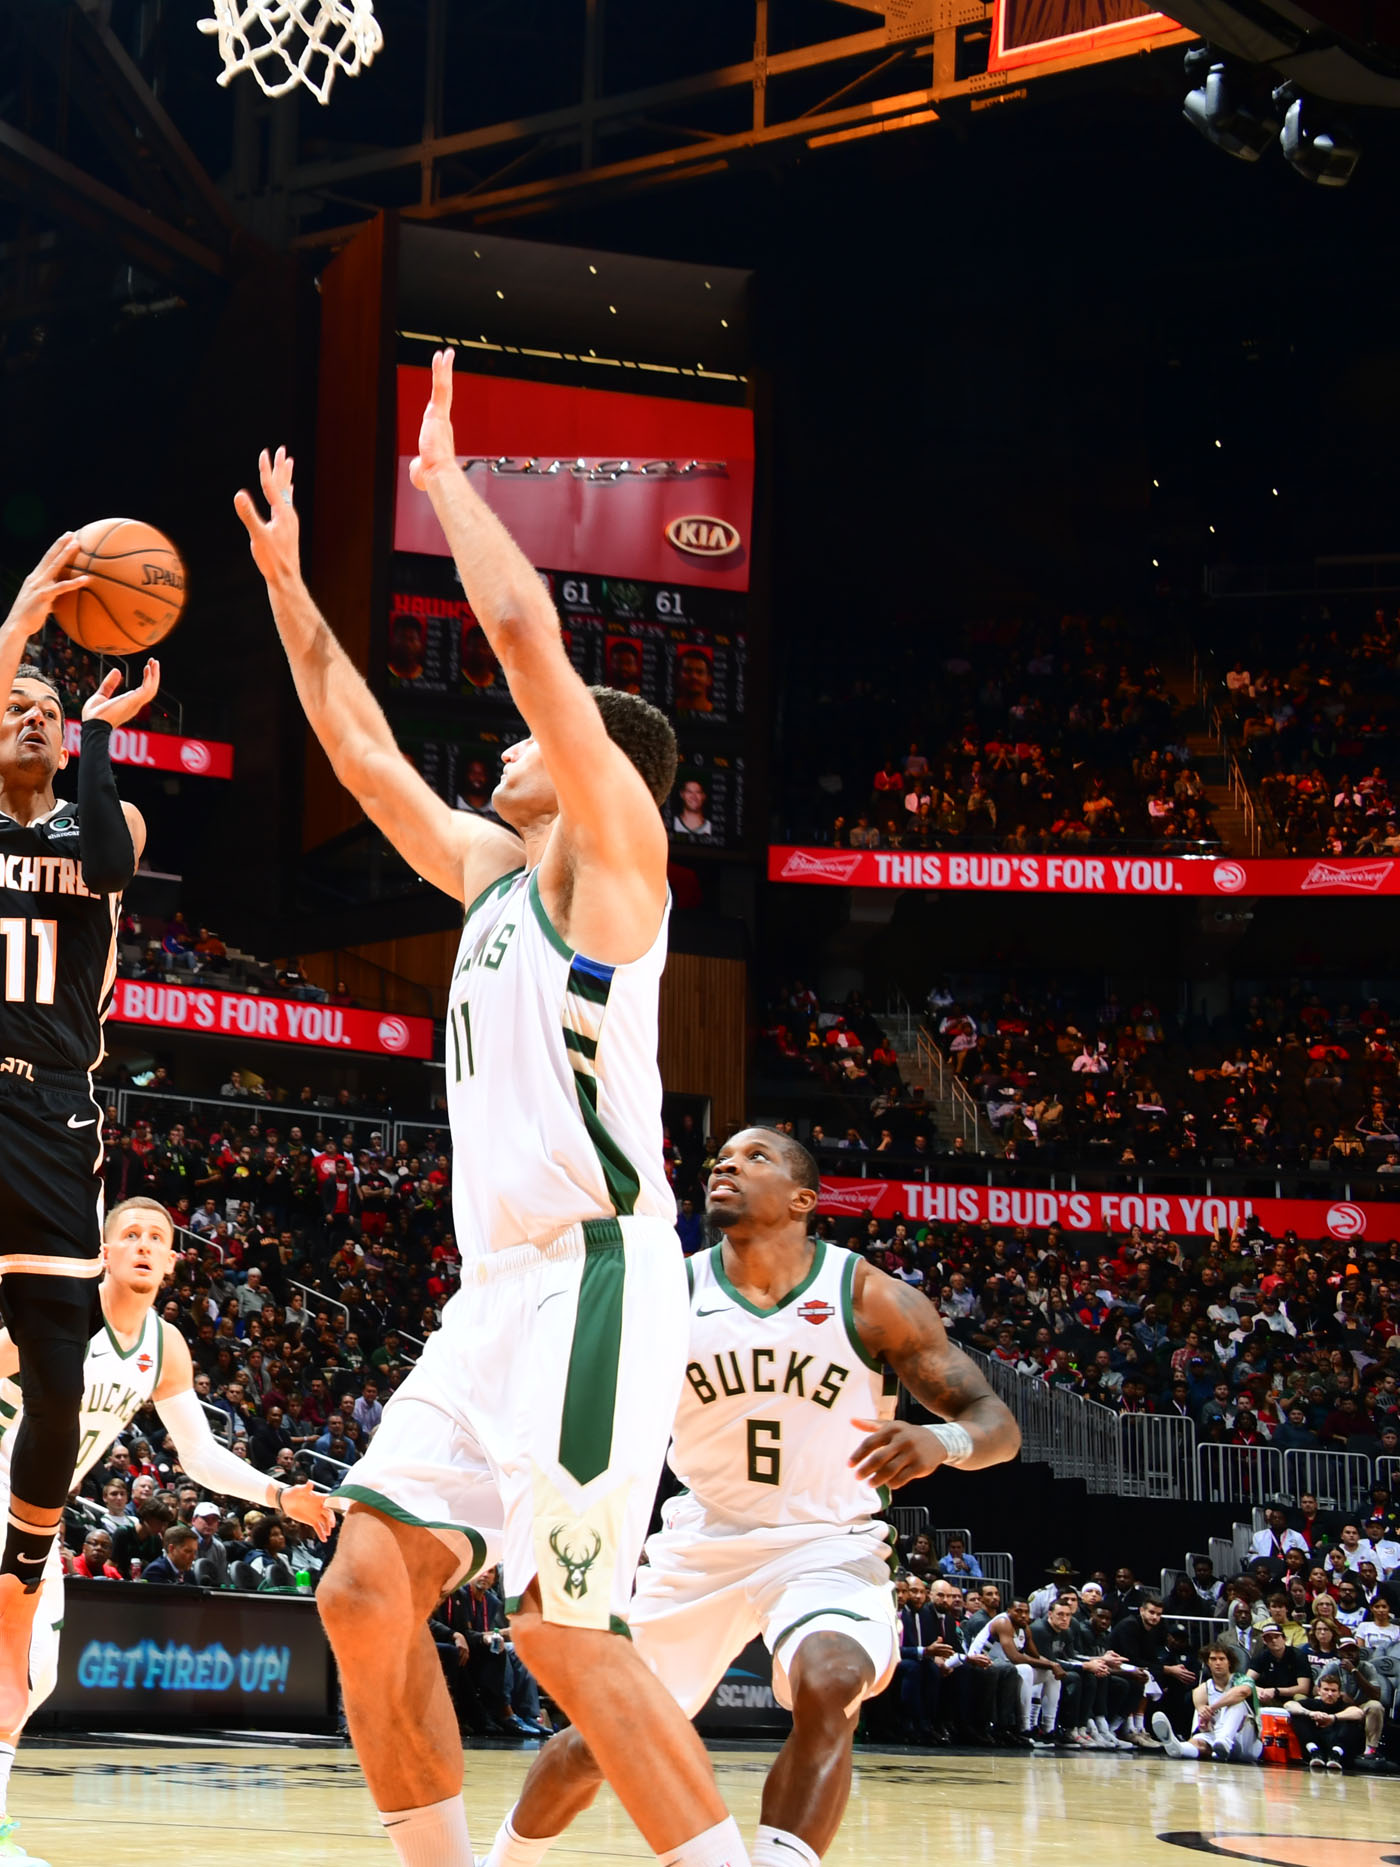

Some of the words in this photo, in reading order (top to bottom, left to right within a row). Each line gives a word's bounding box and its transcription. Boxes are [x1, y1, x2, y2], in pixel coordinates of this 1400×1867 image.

[679, 522, 727, 549] KIA
[563, 580, 591, 604] 61
[656, 590, 683, 615] 61
[109, 728, 155, 766] OU.
[874, 854, 942, 885] THIS
[949, 856, 1039, 888] BUD'S
[1046, 859, 1106, 889] FOR
[1111, 860, 1183, 891] YOU.
[0, 918, 57, 1005] 11
[123, 984, 214, 1027] BUD'S
[220, 995, 279, 1035] FOR
[285, 1005, 351, 1045] YOU.
[450, 1000, 475, 1083] 11
[0, 1057, 35, 1081] ATL
[902, 1183, 979, 1221] THIS
[988, 1189, 1091, 1229] BUD'S
[1102, 1196, 1171, 1232] FOR
[685, 1347, 850, 1410] BUCKS
[80, 1382, 145, 1423] UCKS
[747, 1418, 782, 1486] 6
[77, 1640, 144, 1689] GET
[142, 1638, 234, 1690] FIRED
[239, 1643, 290, 1693] UP!
